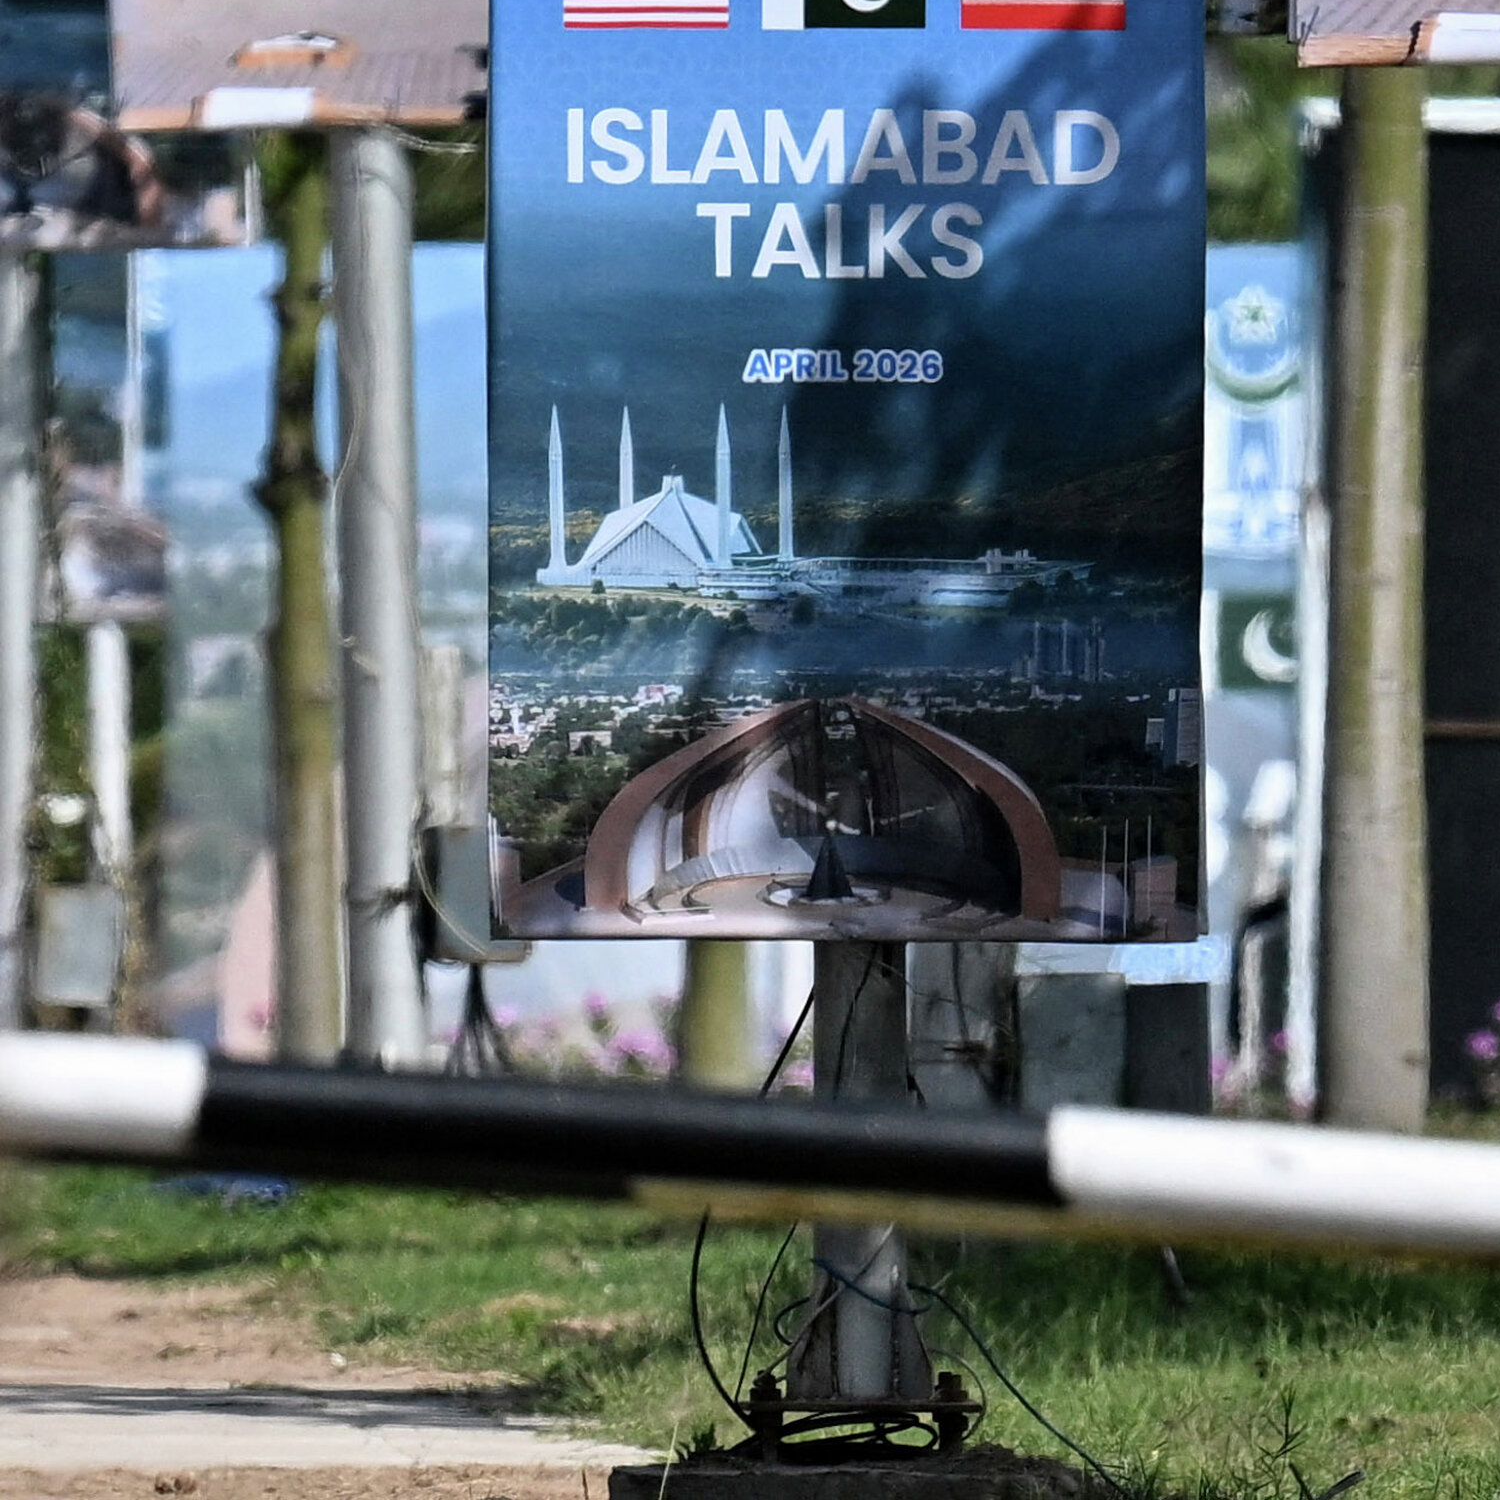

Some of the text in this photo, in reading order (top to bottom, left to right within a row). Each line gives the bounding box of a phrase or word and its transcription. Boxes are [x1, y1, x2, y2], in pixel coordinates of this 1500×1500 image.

[566, 108, 1120, 185] ISLAMABAD
[696, 203, 985, 279] TALKS
[742, 349, 944, 384] APRIL 2026
